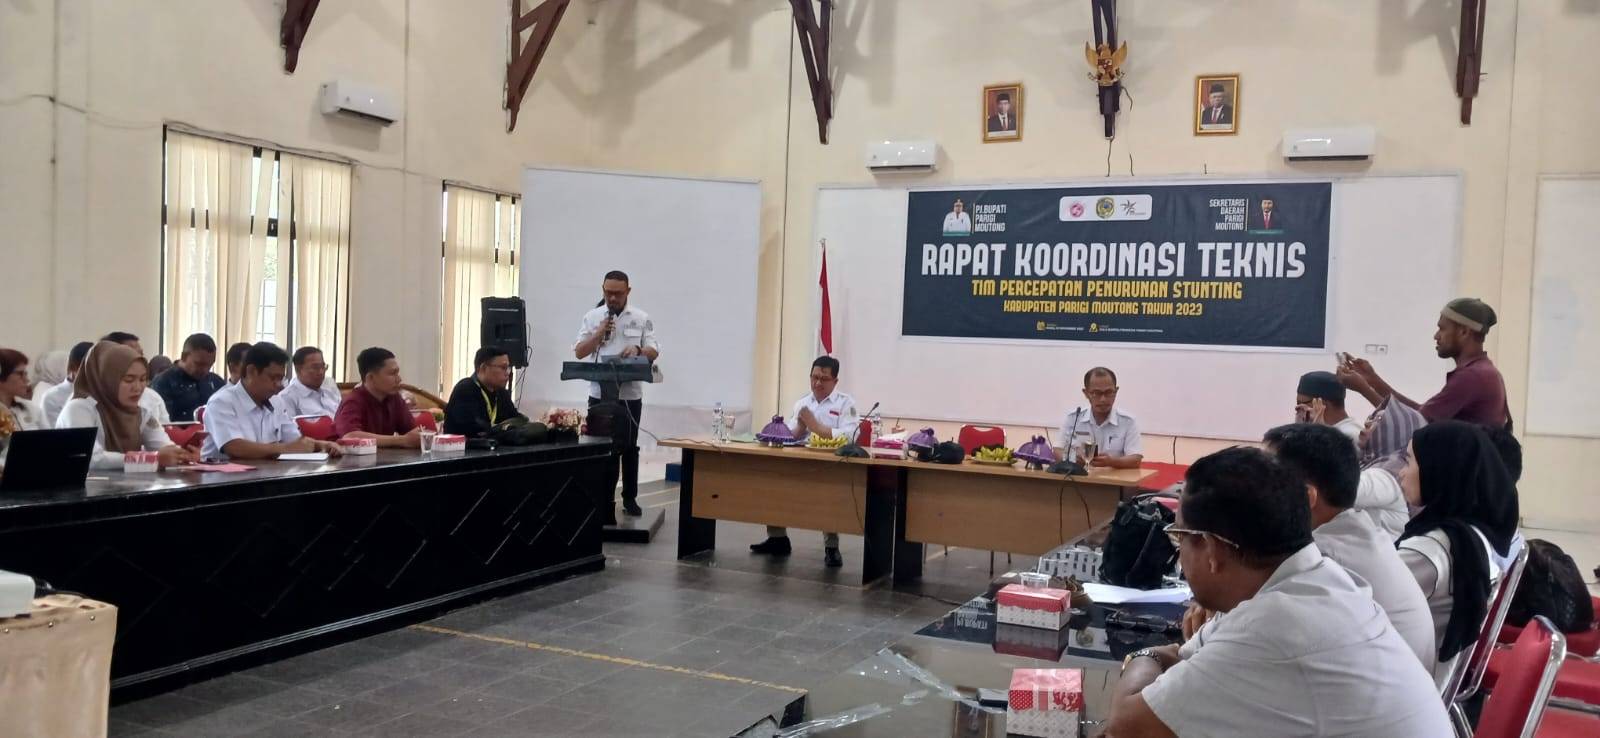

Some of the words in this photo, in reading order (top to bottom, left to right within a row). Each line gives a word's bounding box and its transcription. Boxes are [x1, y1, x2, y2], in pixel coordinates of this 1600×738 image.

[1209, 199, 1244, 207] SEKRETARIS
[975, 204, 1006, 214] PJ.BUPATI
[975, 214, 996, 222] PARIGI
[974, 223, 1006, 232] MOUTONG
[1215, 222, 1243, 230] MOUTONG
[921, 243, 1006, 276] RAPAT
[1014, 242, 1186, 277] KOORDINASI
[1197, 242, 1306, 278] TEKNIS
[972, 279, 996, 296] TIM
[1000, 280, 1082, 297] PERCEPATAN
[1087, 281, 1168, 298] PENURUNAN
[1173, 281, 1242, 299] STUNTING
[1004, 300, 1056, 313] KABUPATEN
[1058, 301, 1089, 314] PARIGI
[1092, 302, 1139, 315] MOUTONG
[1142, 302, 1174, 316] TAHUN
[1176, 303, 1203, 316] 2023
